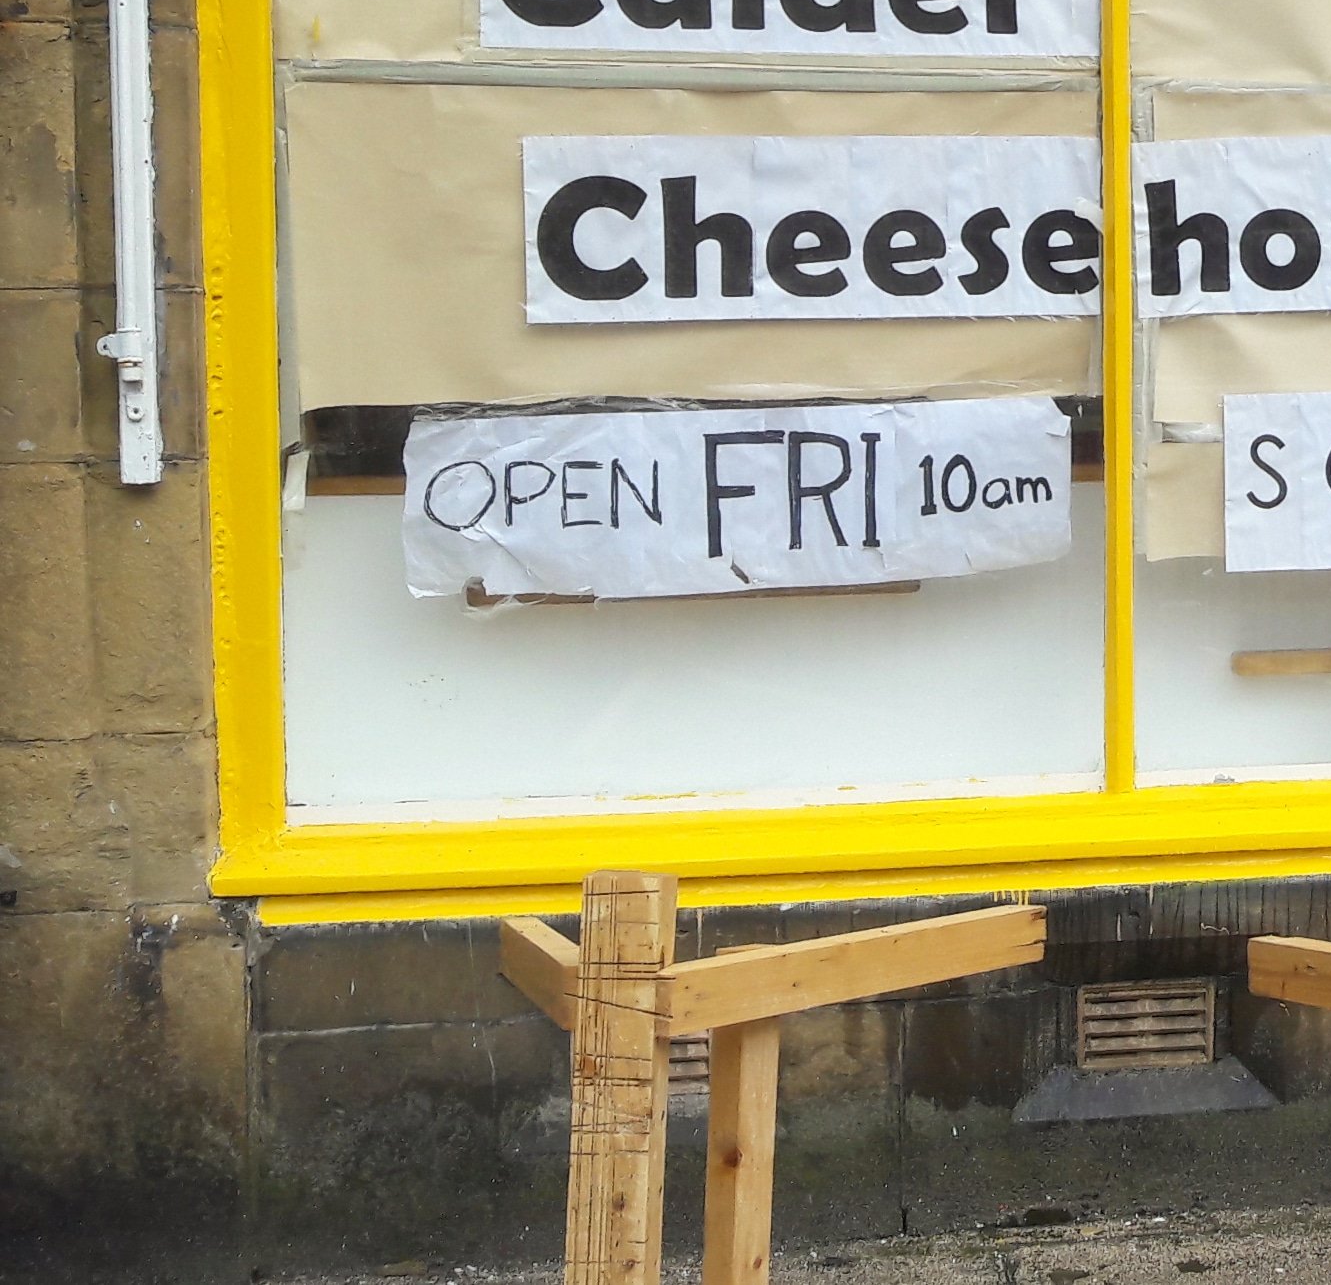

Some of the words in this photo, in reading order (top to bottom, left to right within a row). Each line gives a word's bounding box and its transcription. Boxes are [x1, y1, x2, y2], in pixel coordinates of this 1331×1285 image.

[424, 457, 663, 531] OPEN
[701, 429, 882, 559] FRI
[918, 454, 1053, 515] 10am
